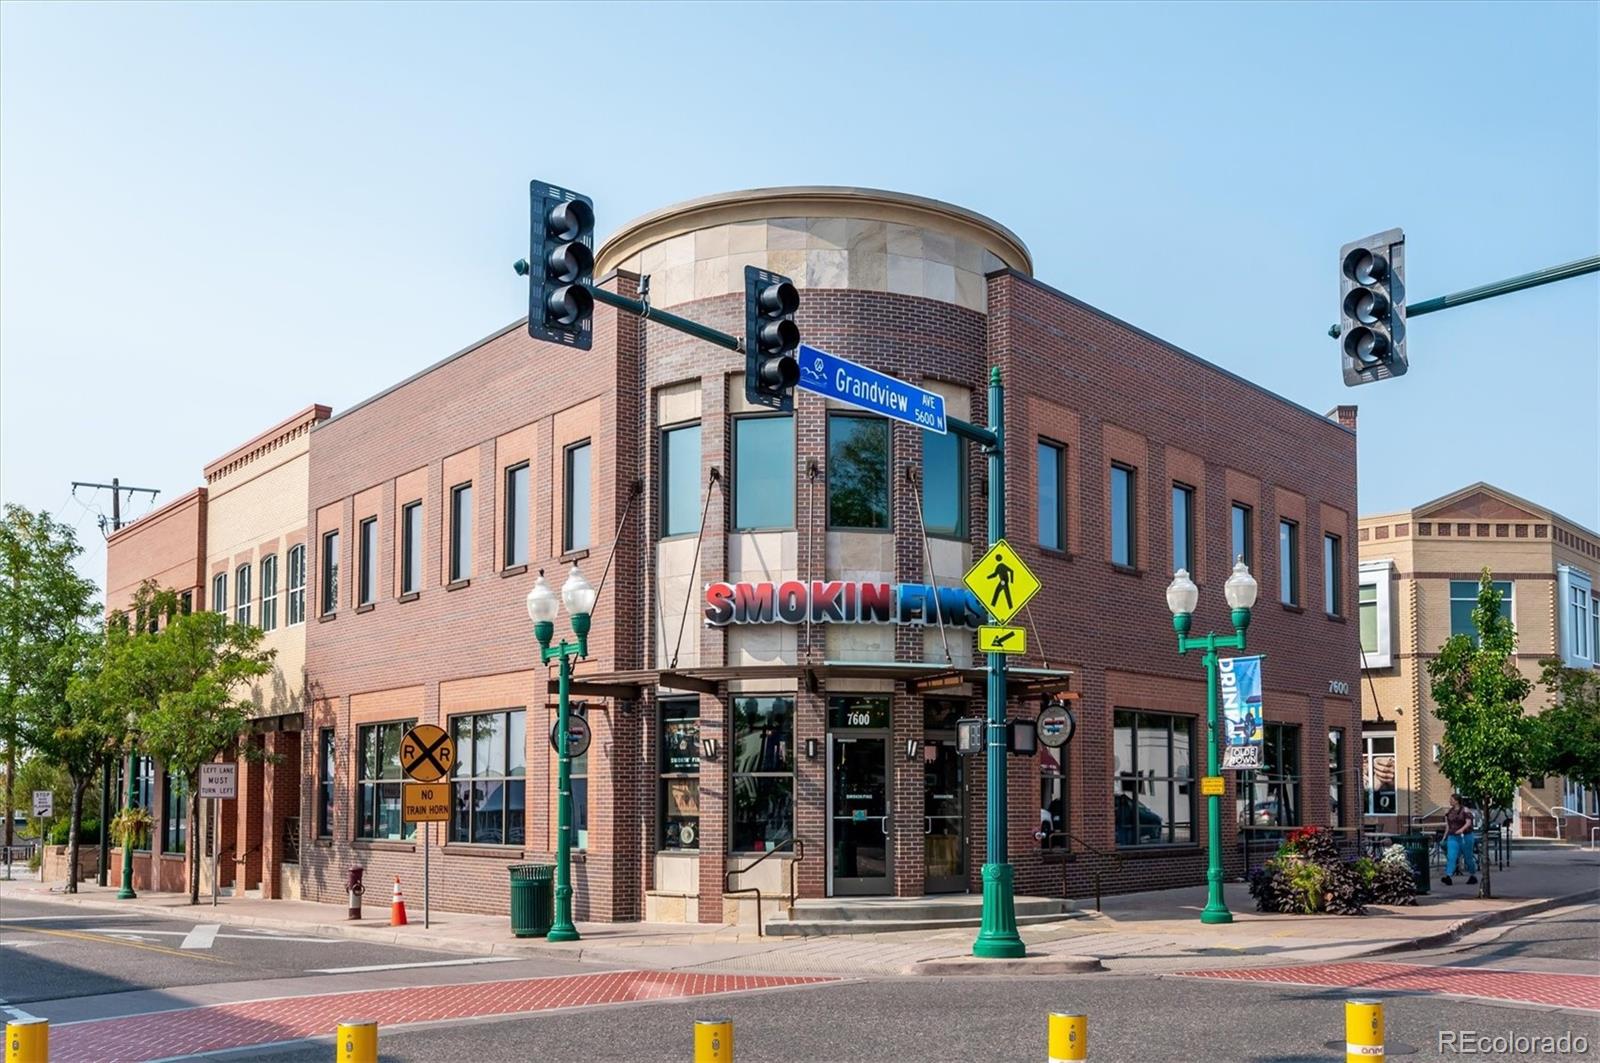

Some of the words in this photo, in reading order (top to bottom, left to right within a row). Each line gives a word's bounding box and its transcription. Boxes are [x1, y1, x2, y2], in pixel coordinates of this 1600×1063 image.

[836, 367, 908, 413] Grandview
[922, 393, 936, 410] AVE
[914, 408, 935, 427] 5600
[937, 415, 944, 430] N
[704, 581, 891, 624] SMOKIN
[1328, 680, 1349, 695] 7600
[847, 713, 870, 726] 7600
[404, 745, 415, 759] R
[440, 747, 451, 761] R
[208, 776, 228, 784] MUST
[421, 790, 433, 800] NO
[407, 806, 427, 815] TRAIN
[429, 806, 448, 815] HORN
